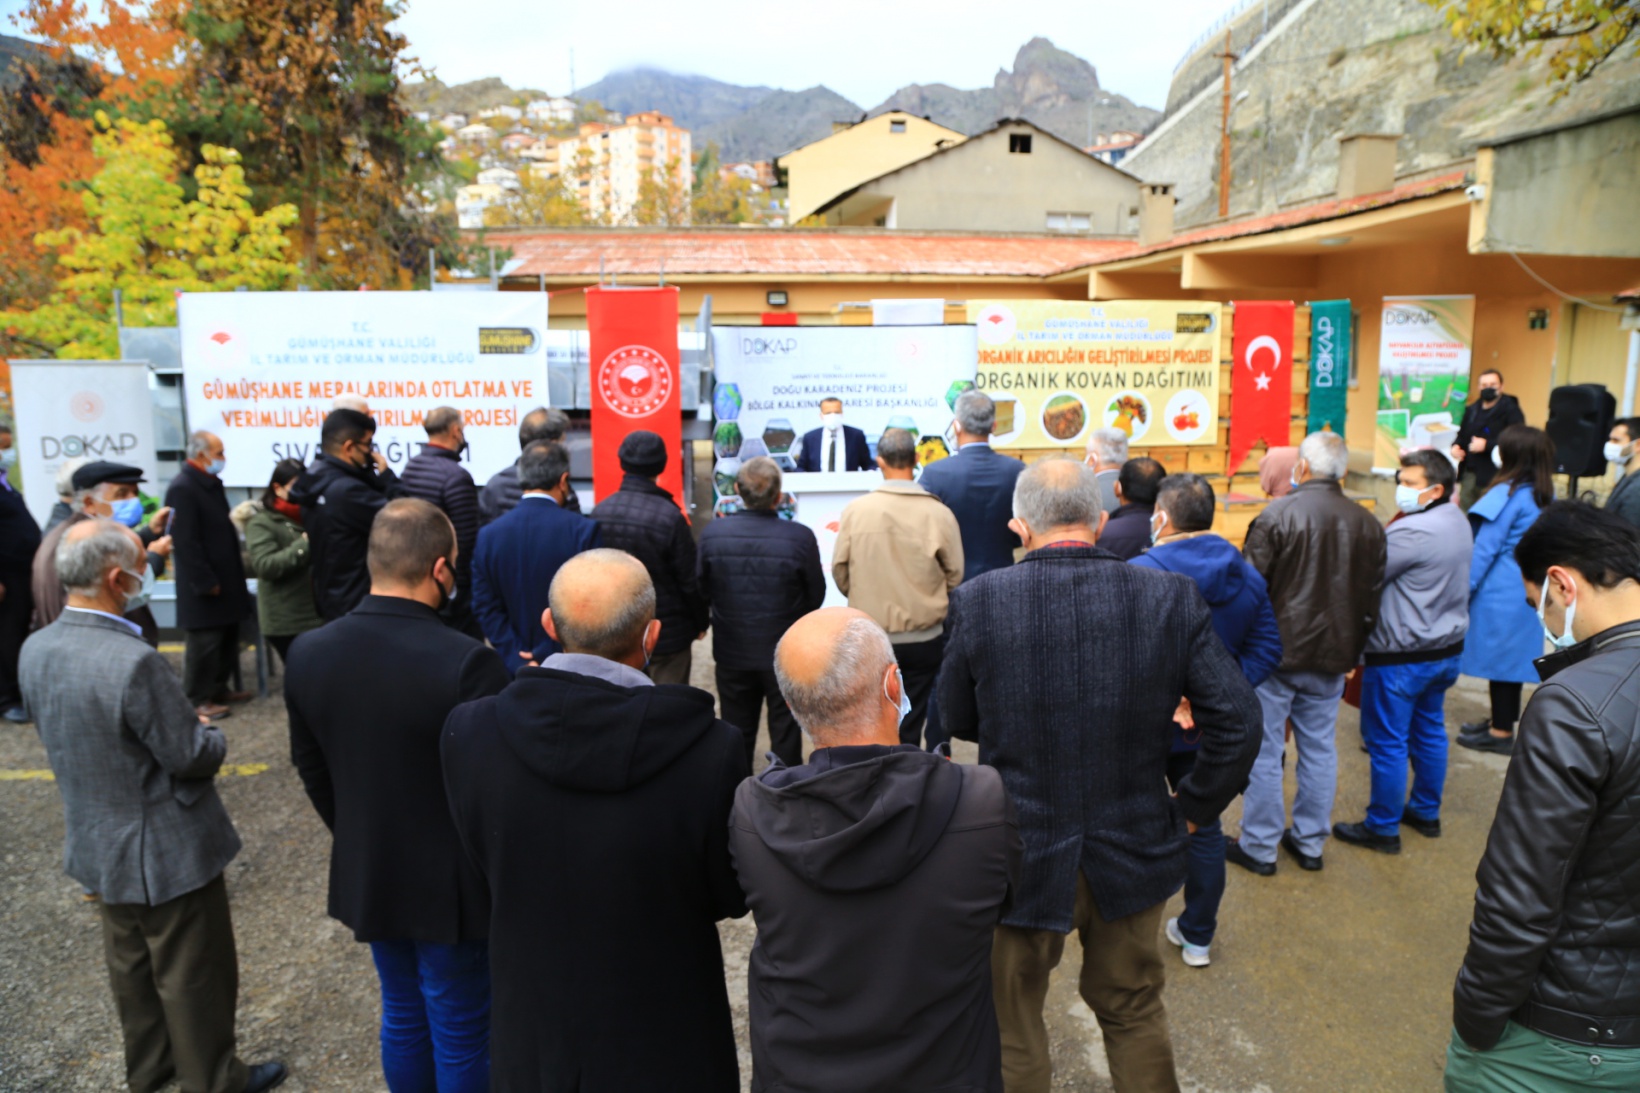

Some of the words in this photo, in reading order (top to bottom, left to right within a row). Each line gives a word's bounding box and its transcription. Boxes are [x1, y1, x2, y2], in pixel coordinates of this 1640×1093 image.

[1385, 310, 1437, 325] DOKAP
[743, 337, 798, 355] DOKAP
[1063, 332, 1074, 340] VE
[267, 353, 309, 365] TARIM
[313, 353, 330, 365] VE
[334, 353, 384, 365] ORMAN
[1315, 316, 1335, 387] DOKAP
[975, 367, 1059, 389] ORGANİK
[1066, 371, 1126, 389] KOVAN
[1133, 366, 1212, 388] DAĞITIMI
[203, 377, 303, 402] GÜMÜŞHANE
[432, 380, 507, 398] OTLATMA
[511, 380, 532, 397] VE
[41, 432, 138, 460] DOKAP
